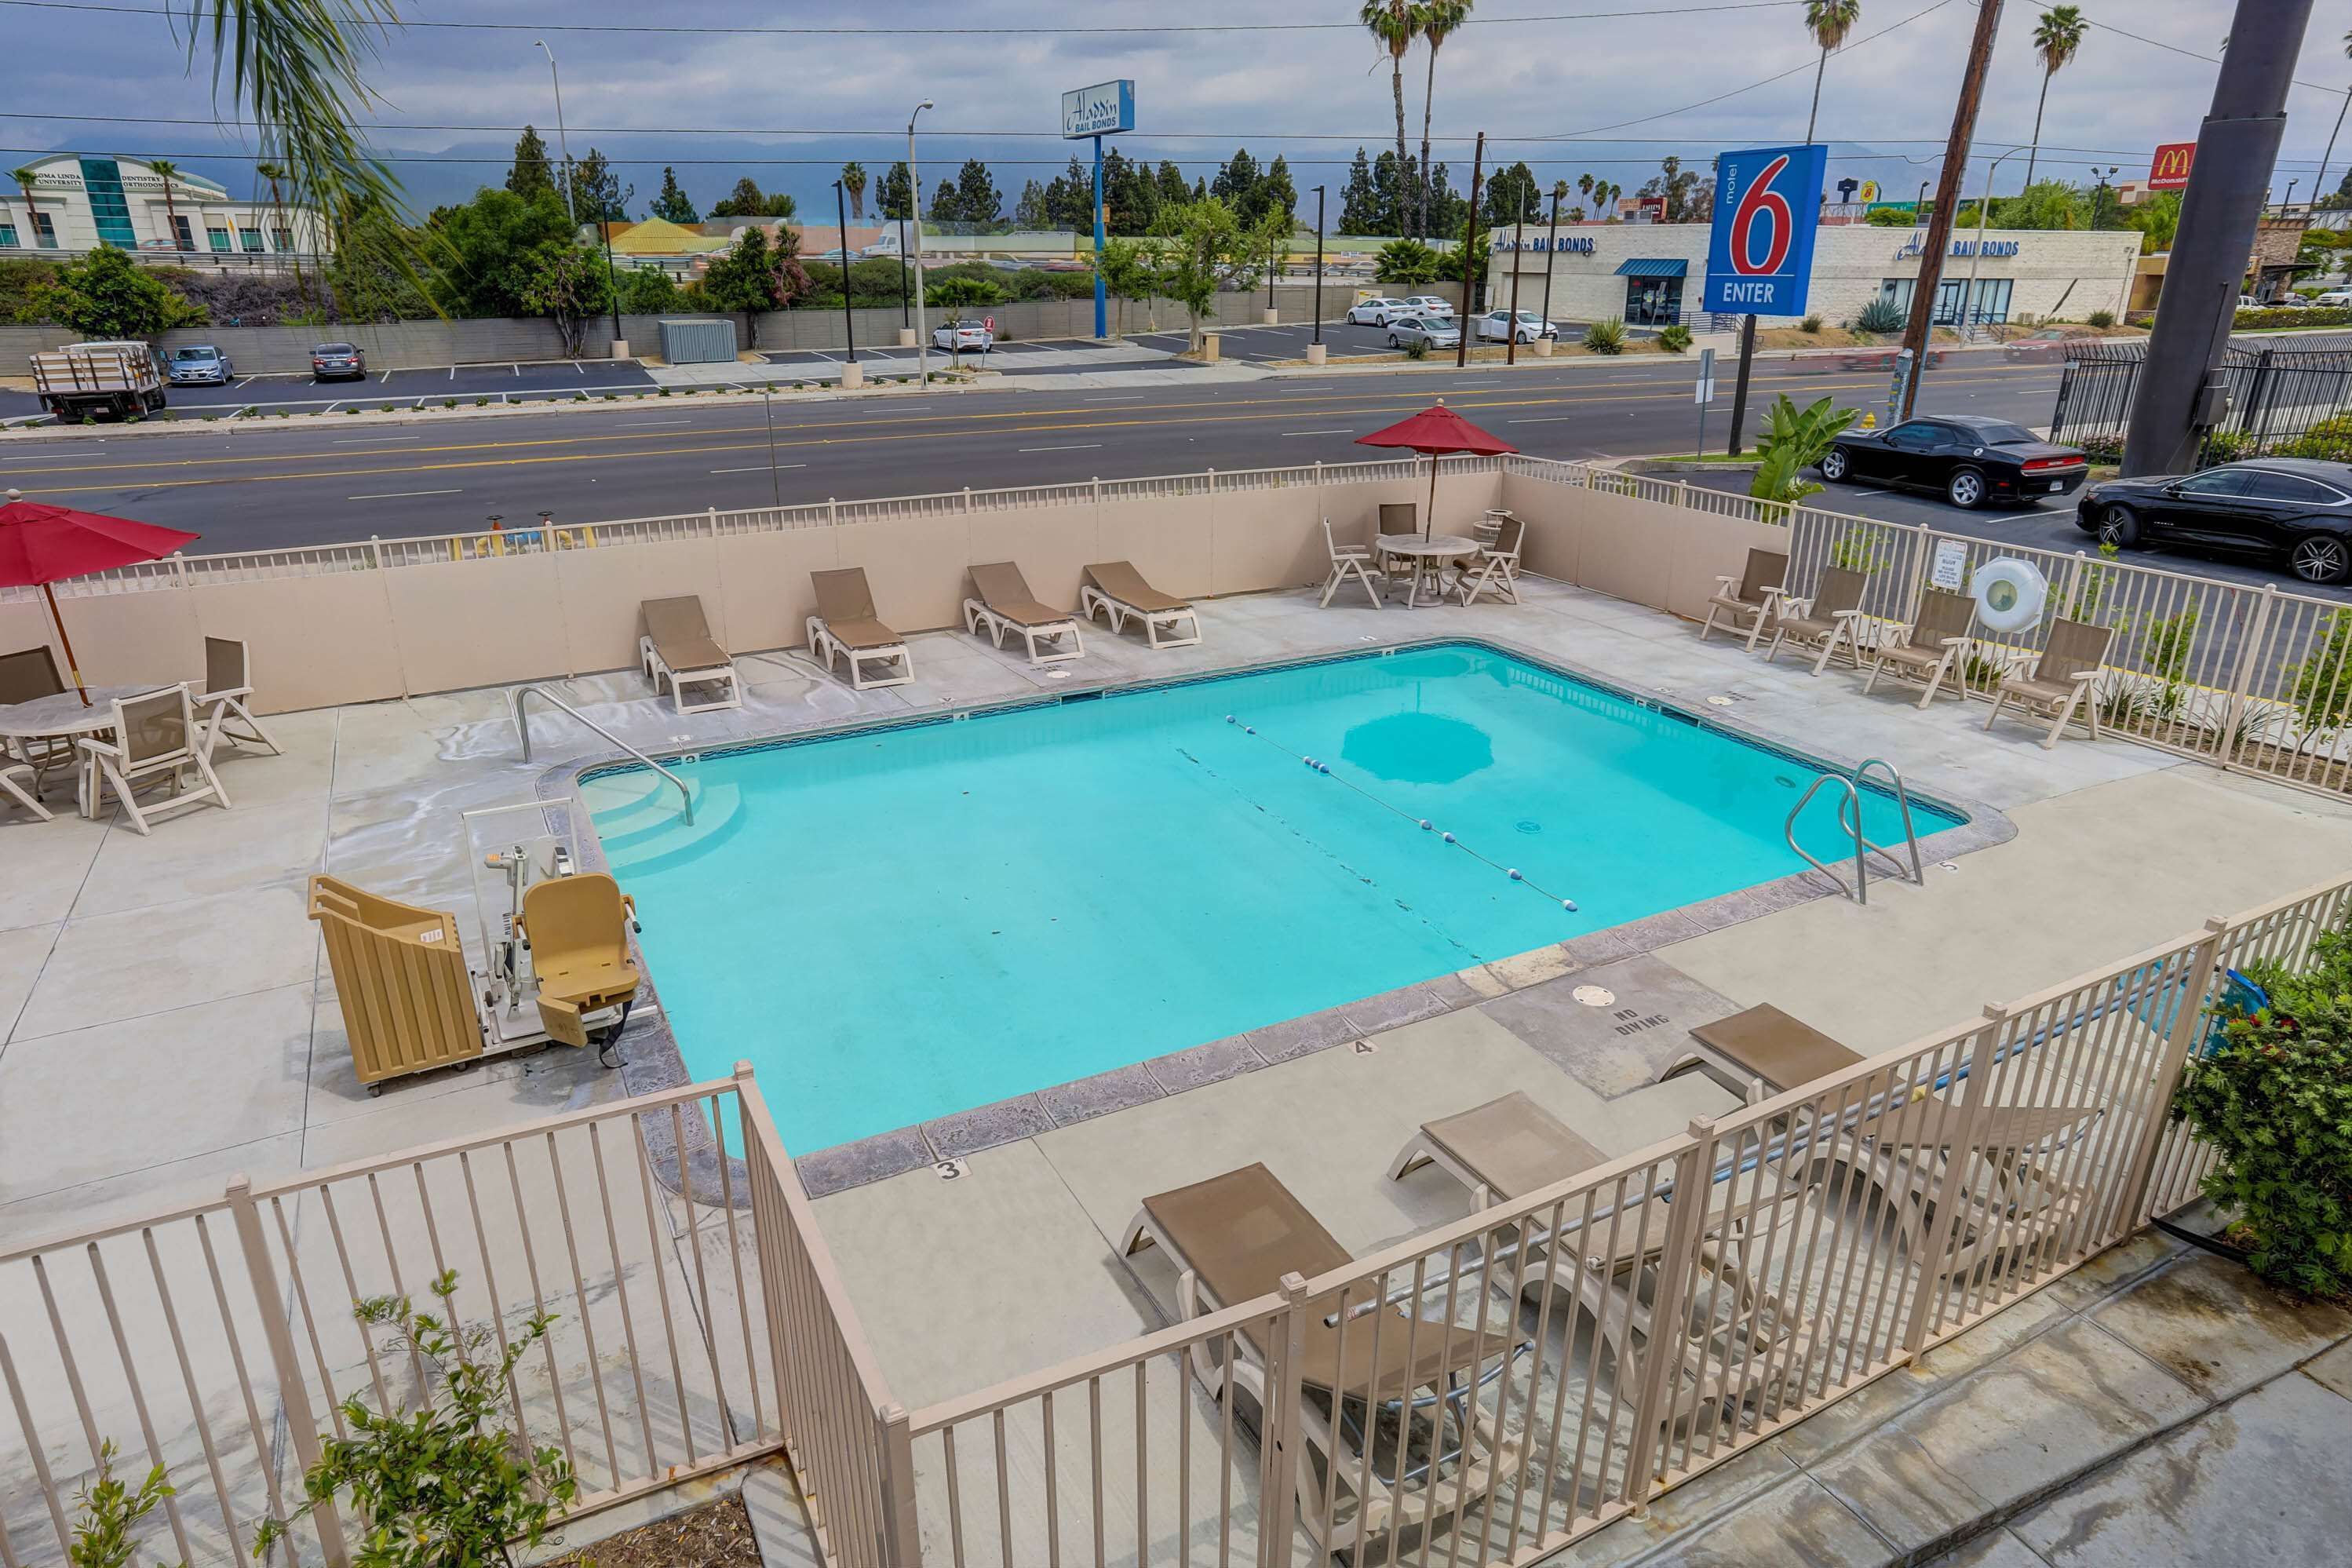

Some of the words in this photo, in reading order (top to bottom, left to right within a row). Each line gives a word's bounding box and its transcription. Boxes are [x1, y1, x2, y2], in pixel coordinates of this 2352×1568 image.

[1075, 122, 1090, 133] BAIL
[1092, 117, 1116, 129] BONDS
[1727, 164, 1738, 204] motel
[1729, 154, 1793, 275] 6
[1488, 229, 1530, 256] Aladin
[1533, 238, 1553, 251] BAI
[1557, 237, 1594, 251] BONDS
[1953, 240, 1977, 255] BAIL
[1982, 241, 2019, 256] BONDS
[1723, 283, 1774, 303] ENTER
[1614, 1008, 1638, 1021] NO
[1614, 1014, 1670, 1036] DIVING
[1355, 1041, 1373, 1054] 4
[937, 1161, 960, 1180] 3
